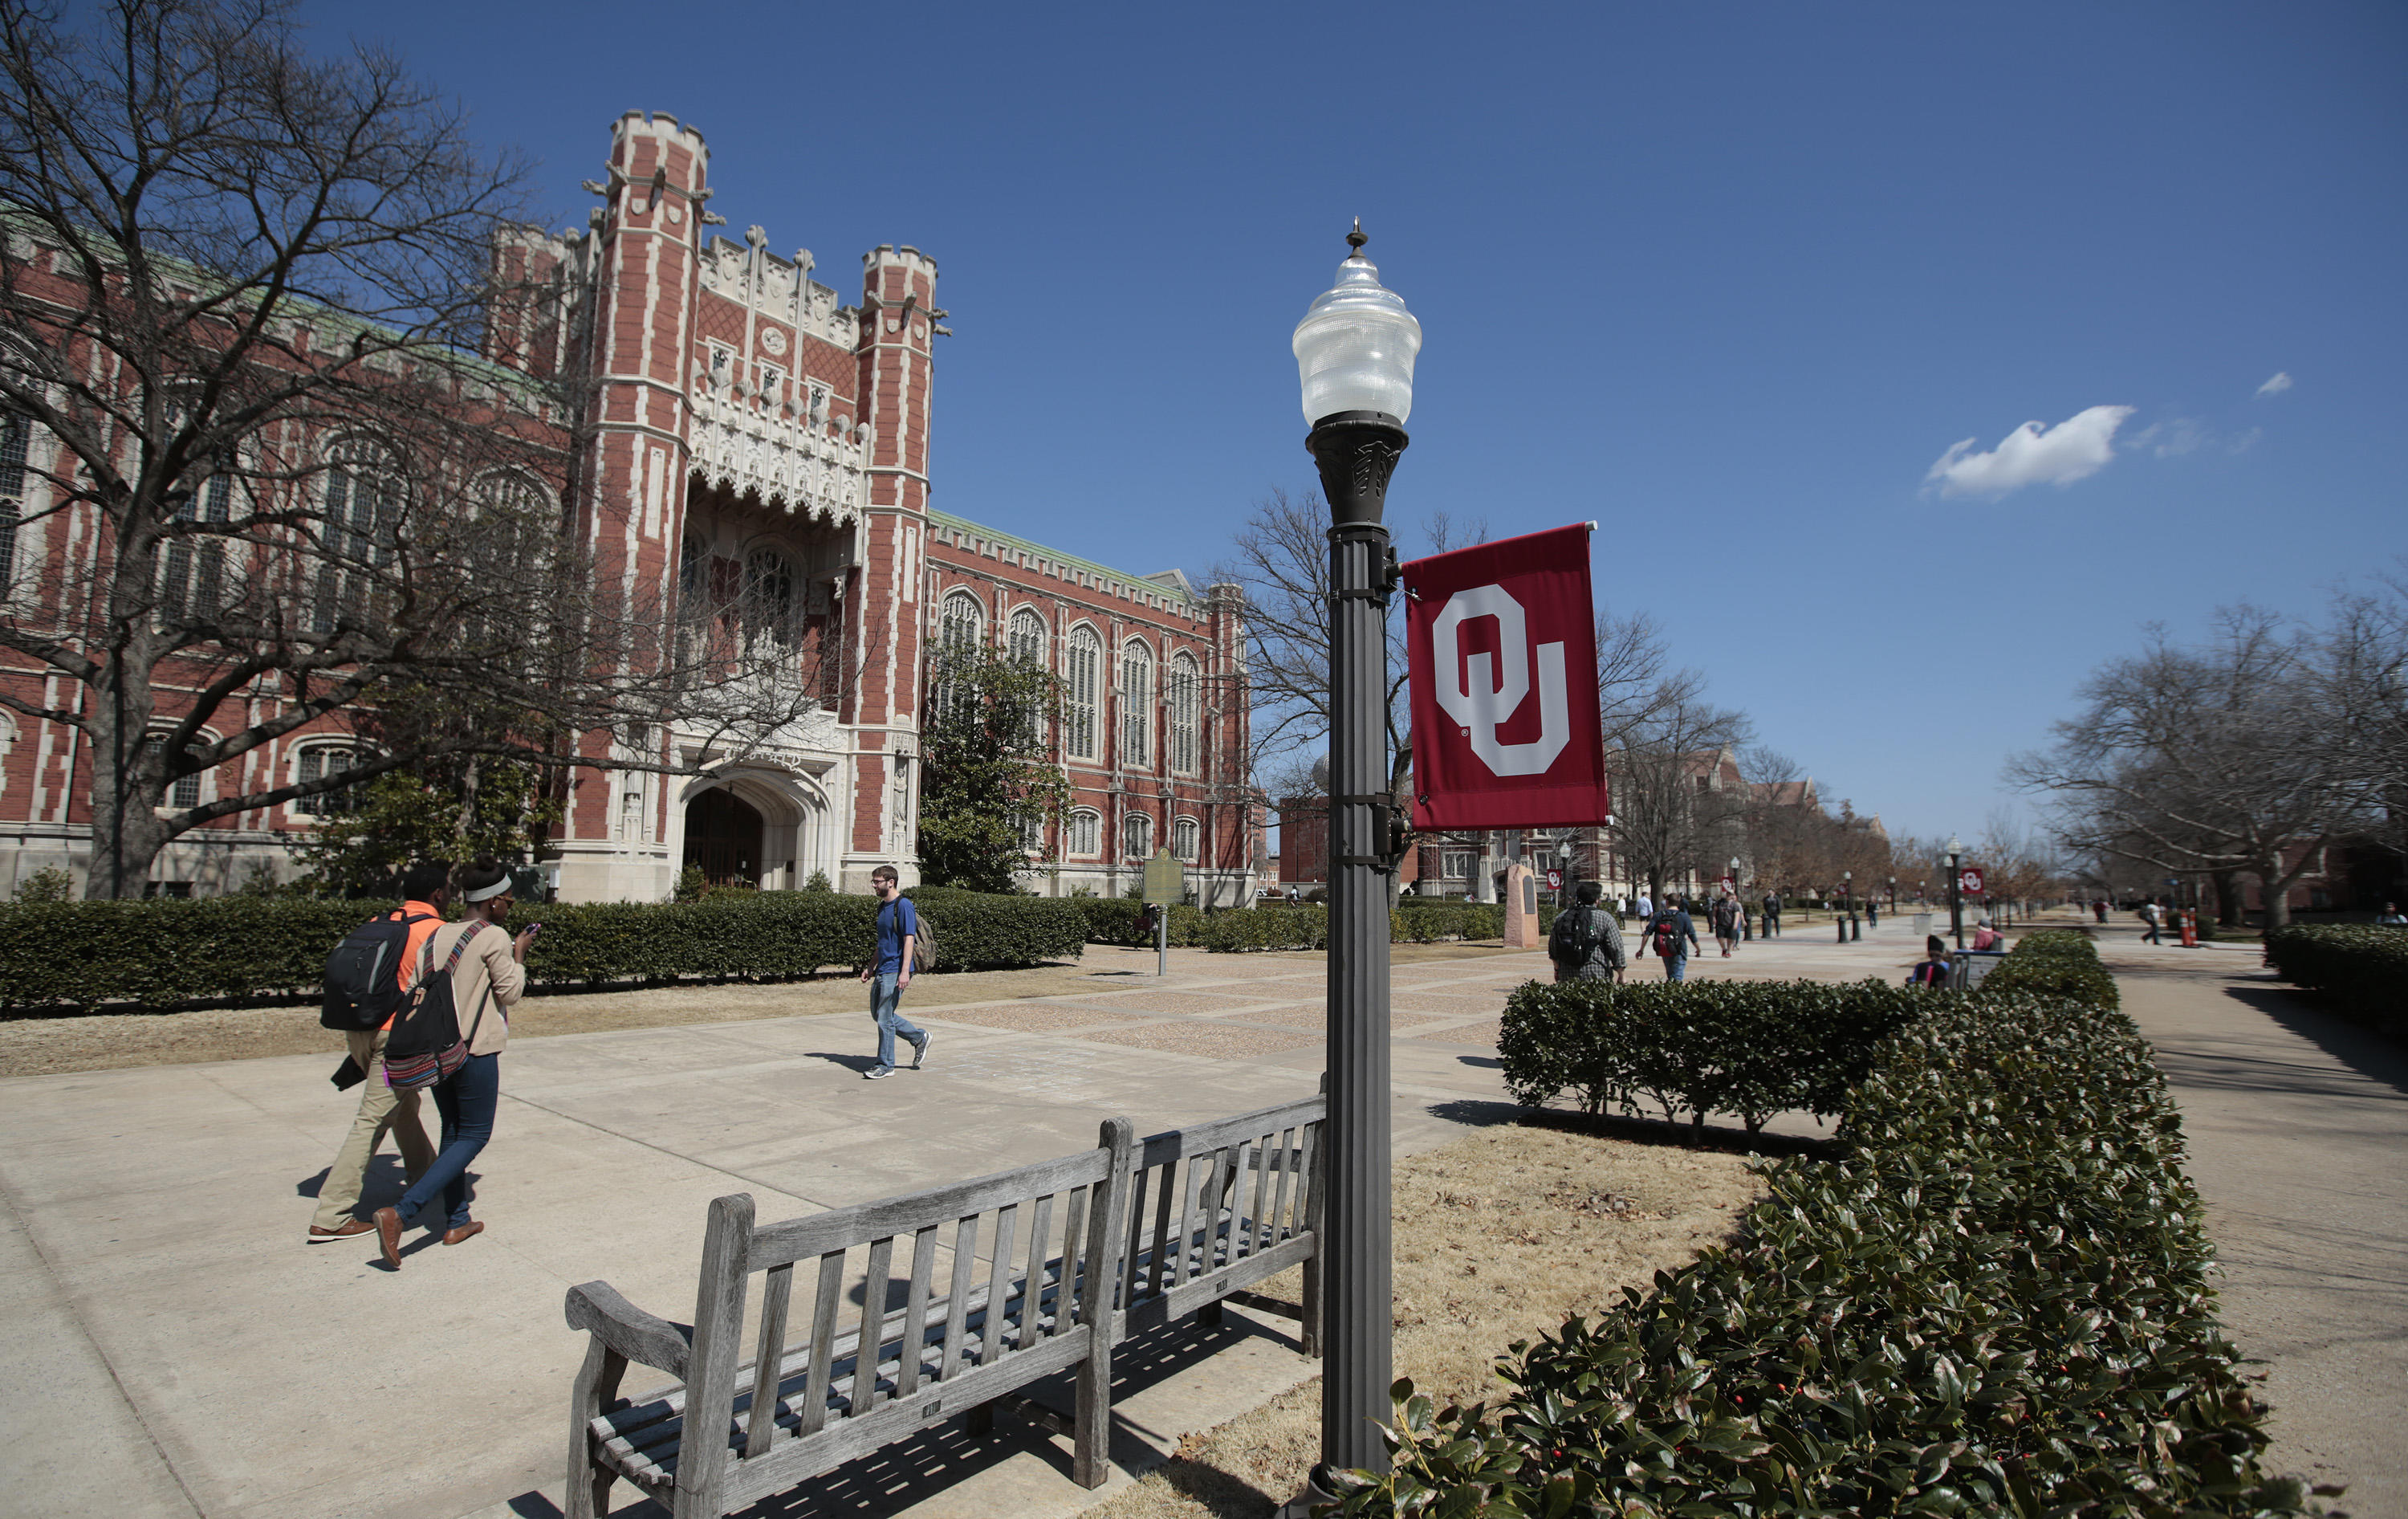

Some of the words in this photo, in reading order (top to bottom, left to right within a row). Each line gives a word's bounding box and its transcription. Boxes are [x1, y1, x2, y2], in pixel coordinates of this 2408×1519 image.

[1433, 584, 1570, 777] OU
[1548, 872, 1560, 887] OU
[1964, 872, 1982, 890] OU
